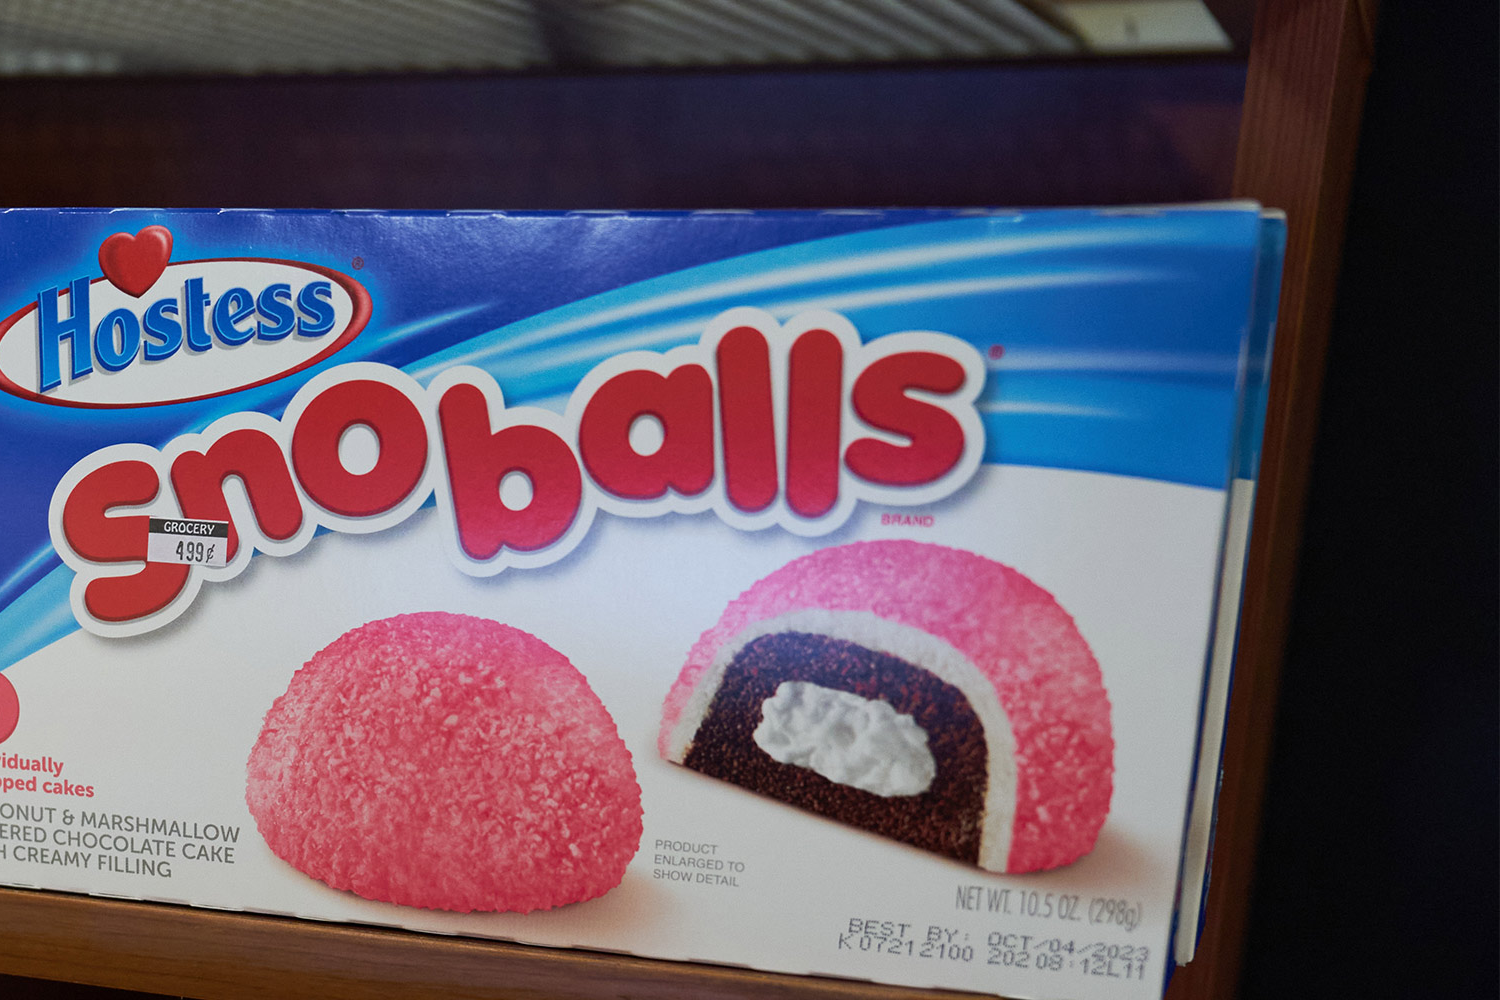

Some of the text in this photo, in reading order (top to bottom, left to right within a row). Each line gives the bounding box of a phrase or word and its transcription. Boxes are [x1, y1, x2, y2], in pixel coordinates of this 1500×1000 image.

[37, 275, 336, 392] Hostess
[163, 521, 216, 535] GROCERY
[881, 513, 936, 529] BRAND
[175, 541, 217, 564] 499¢
[42, 778, 95, 798] cakes
[62, 809, 75, 825] &
[82, 811, 240, 843] MARSHMALLOW
[53, 830, 176, 858] CHOCOLATE
[182, 844, 235, 864] CAKE
[655, 840, 718, 855] PRODUCT
[13, 845, 91, 869] CREAMY
[98, 854, 172, 878] FILLING
[654, 854, 745, 873] ENLARGED TO
[653, 869, 740, 887] SHOW DETAIL
[956, 885, 1143, 932] NET WT. 10.5 OZ. (298g)
[849, 918, 1149, 961] BEST BY: OCT/04/2023
